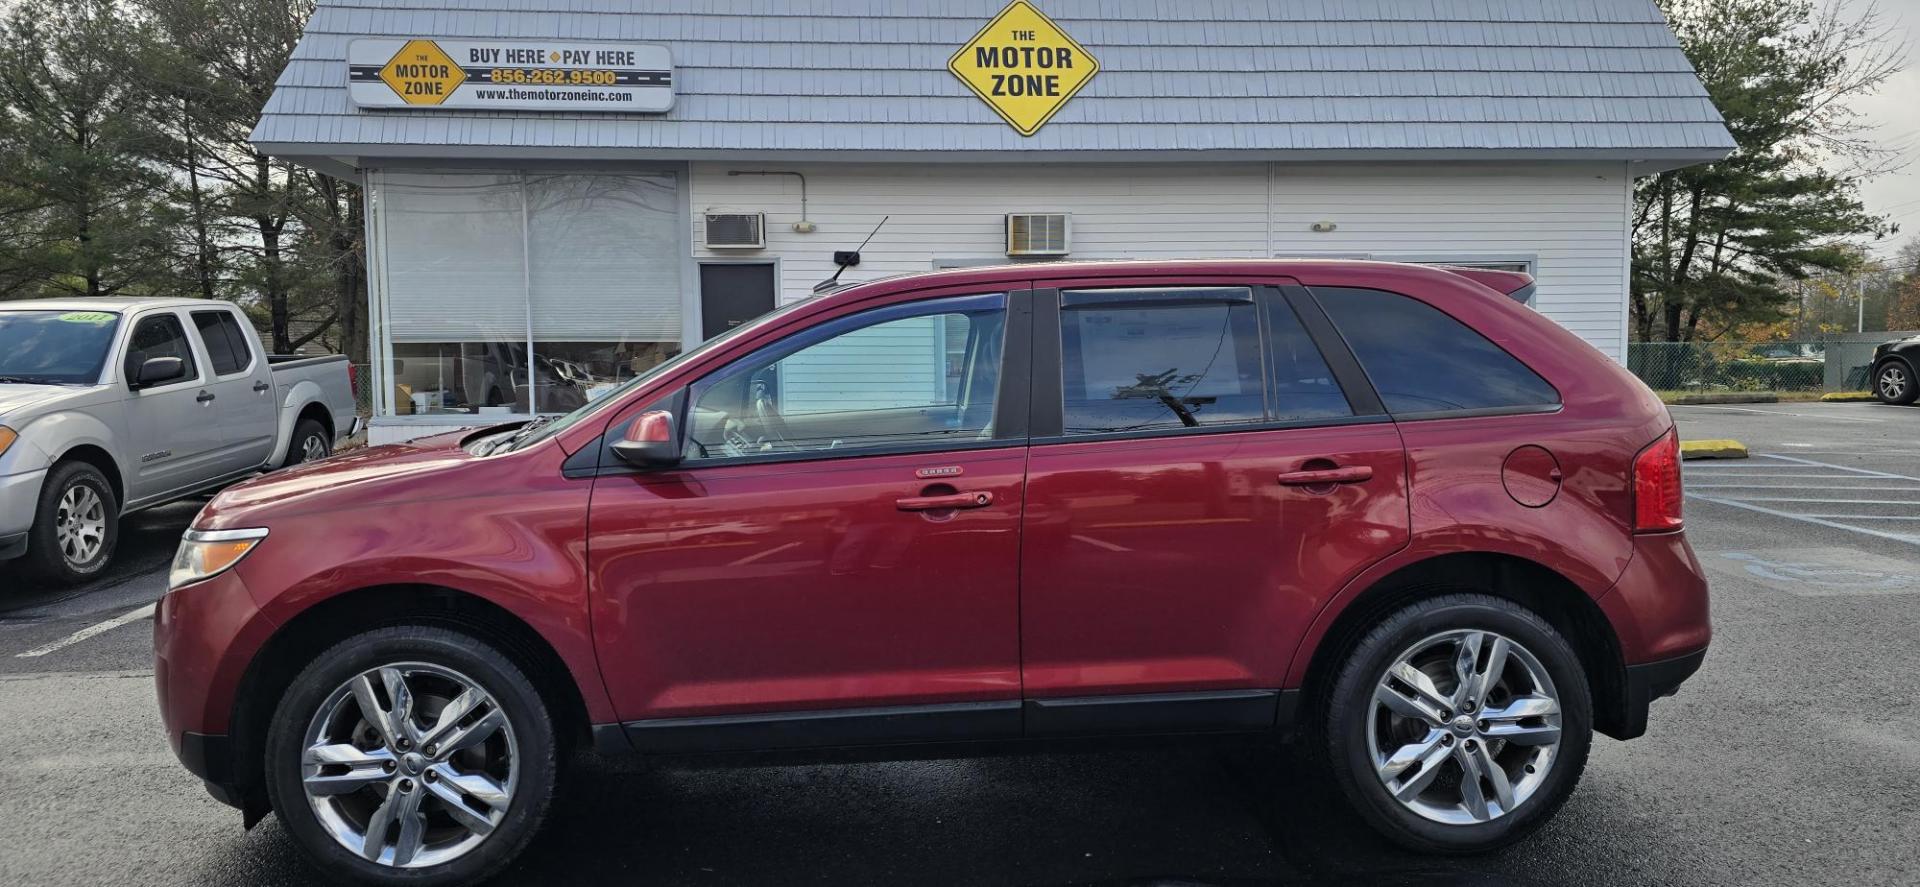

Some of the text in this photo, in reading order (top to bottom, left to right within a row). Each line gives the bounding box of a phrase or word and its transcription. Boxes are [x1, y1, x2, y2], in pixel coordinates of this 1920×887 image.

[1012, 30, 1035, 41] THE
[470, 48, 635, 65] BUY HERE PAY HERE
[976, 46, 1073, 69] MOTOR
[395, 64, 449, 78] MOTOR
[490, 69, 617, 85] 856.262.9500
[404, 82, 443, 95] ZONE
[991, 74, 1060, 97] ZONE
[476, 89, 633, 102] www.themotorzoneinc.com
